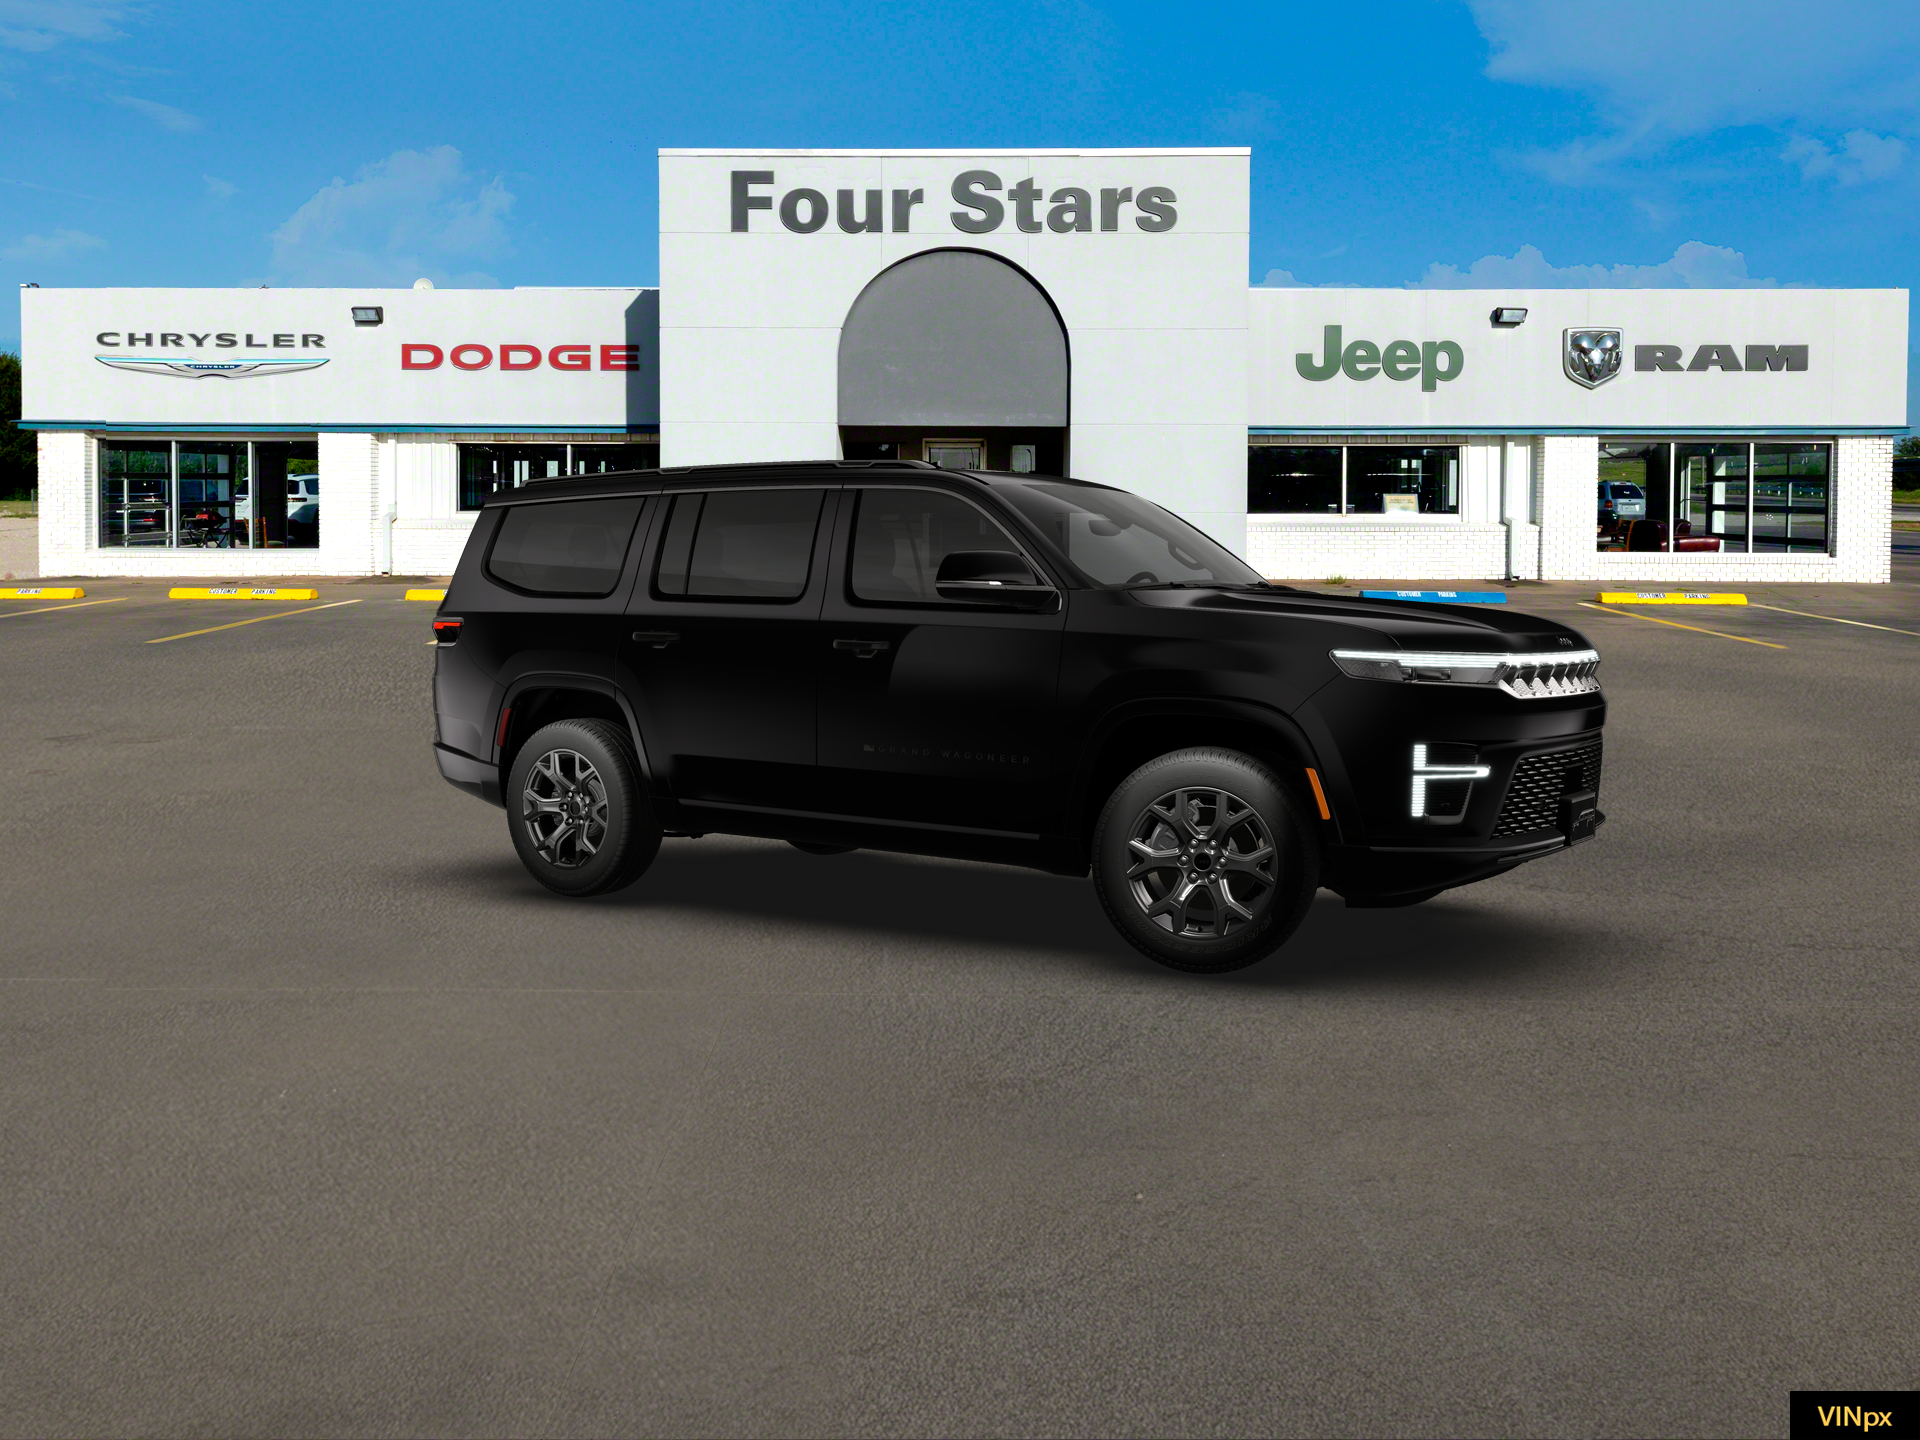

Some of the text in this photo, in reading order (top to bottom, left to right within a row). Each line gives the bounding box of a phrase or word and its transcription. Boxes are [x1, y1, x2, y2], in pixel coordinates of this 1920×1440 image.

[730, 169, 1178, 234] Four Stars
[95, 331, 327, 349] CHRYSLER
[401, 343, 641, 371] DODGE
[1295, 324, 1465, 393] Jeep
[1634, 343, 1809, 372] RAM
[878, 745, 1030, 764] GRAND WAGONEER
